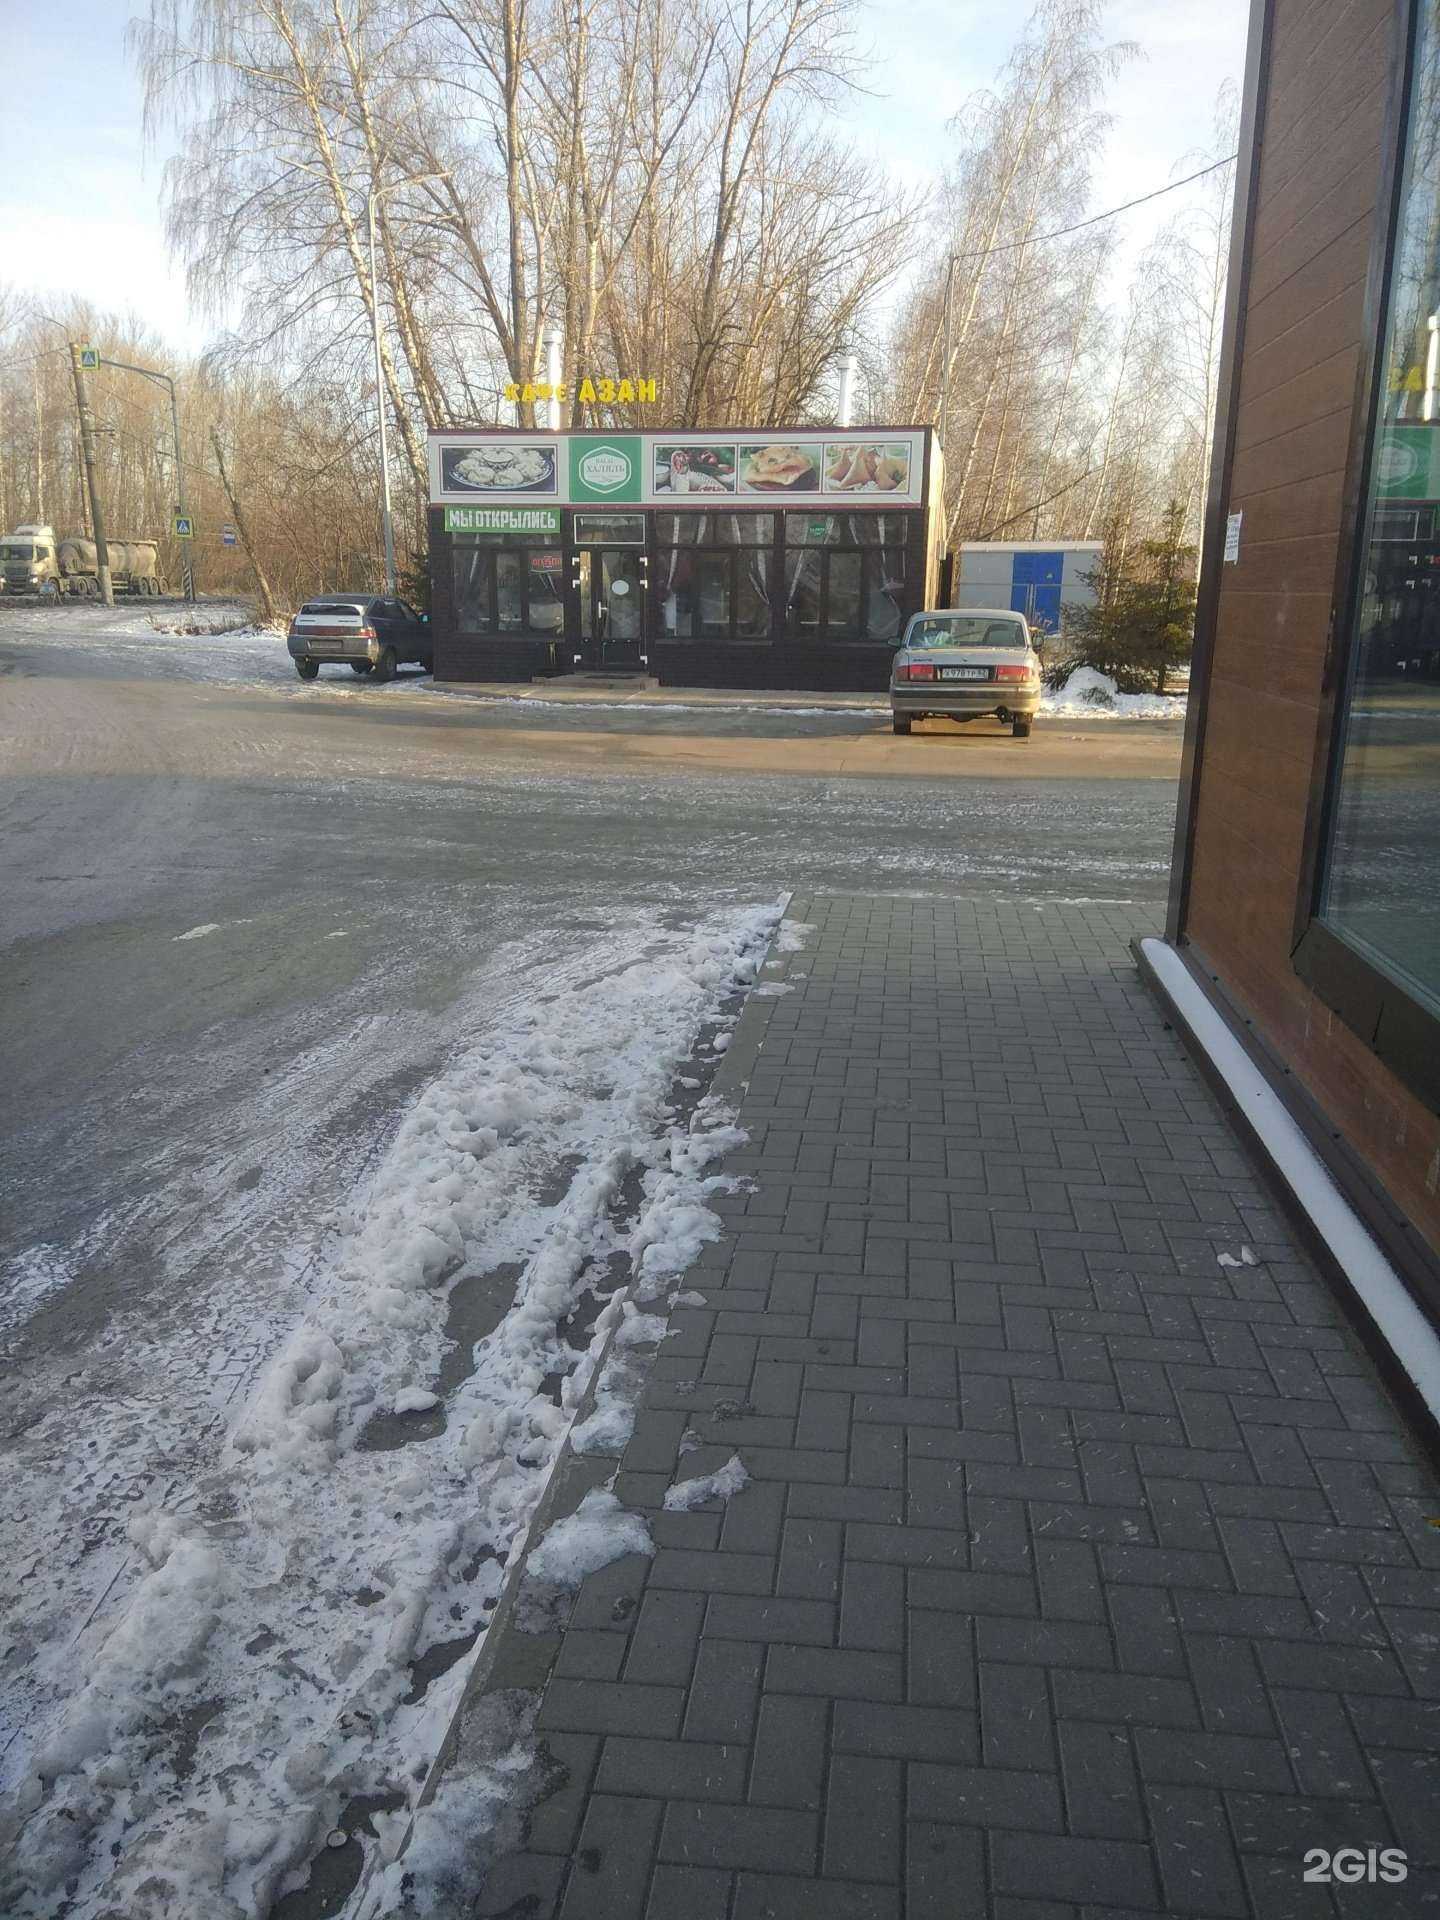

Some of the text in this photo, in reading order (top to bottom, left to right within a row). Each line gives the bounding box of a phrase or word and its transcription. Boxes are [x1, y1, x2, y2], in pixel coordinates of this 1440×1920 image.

[579, 378, 656, 402] АЗАН
[449, 510, 556, 529] МЫ ОТКРЫЛИСЬ
